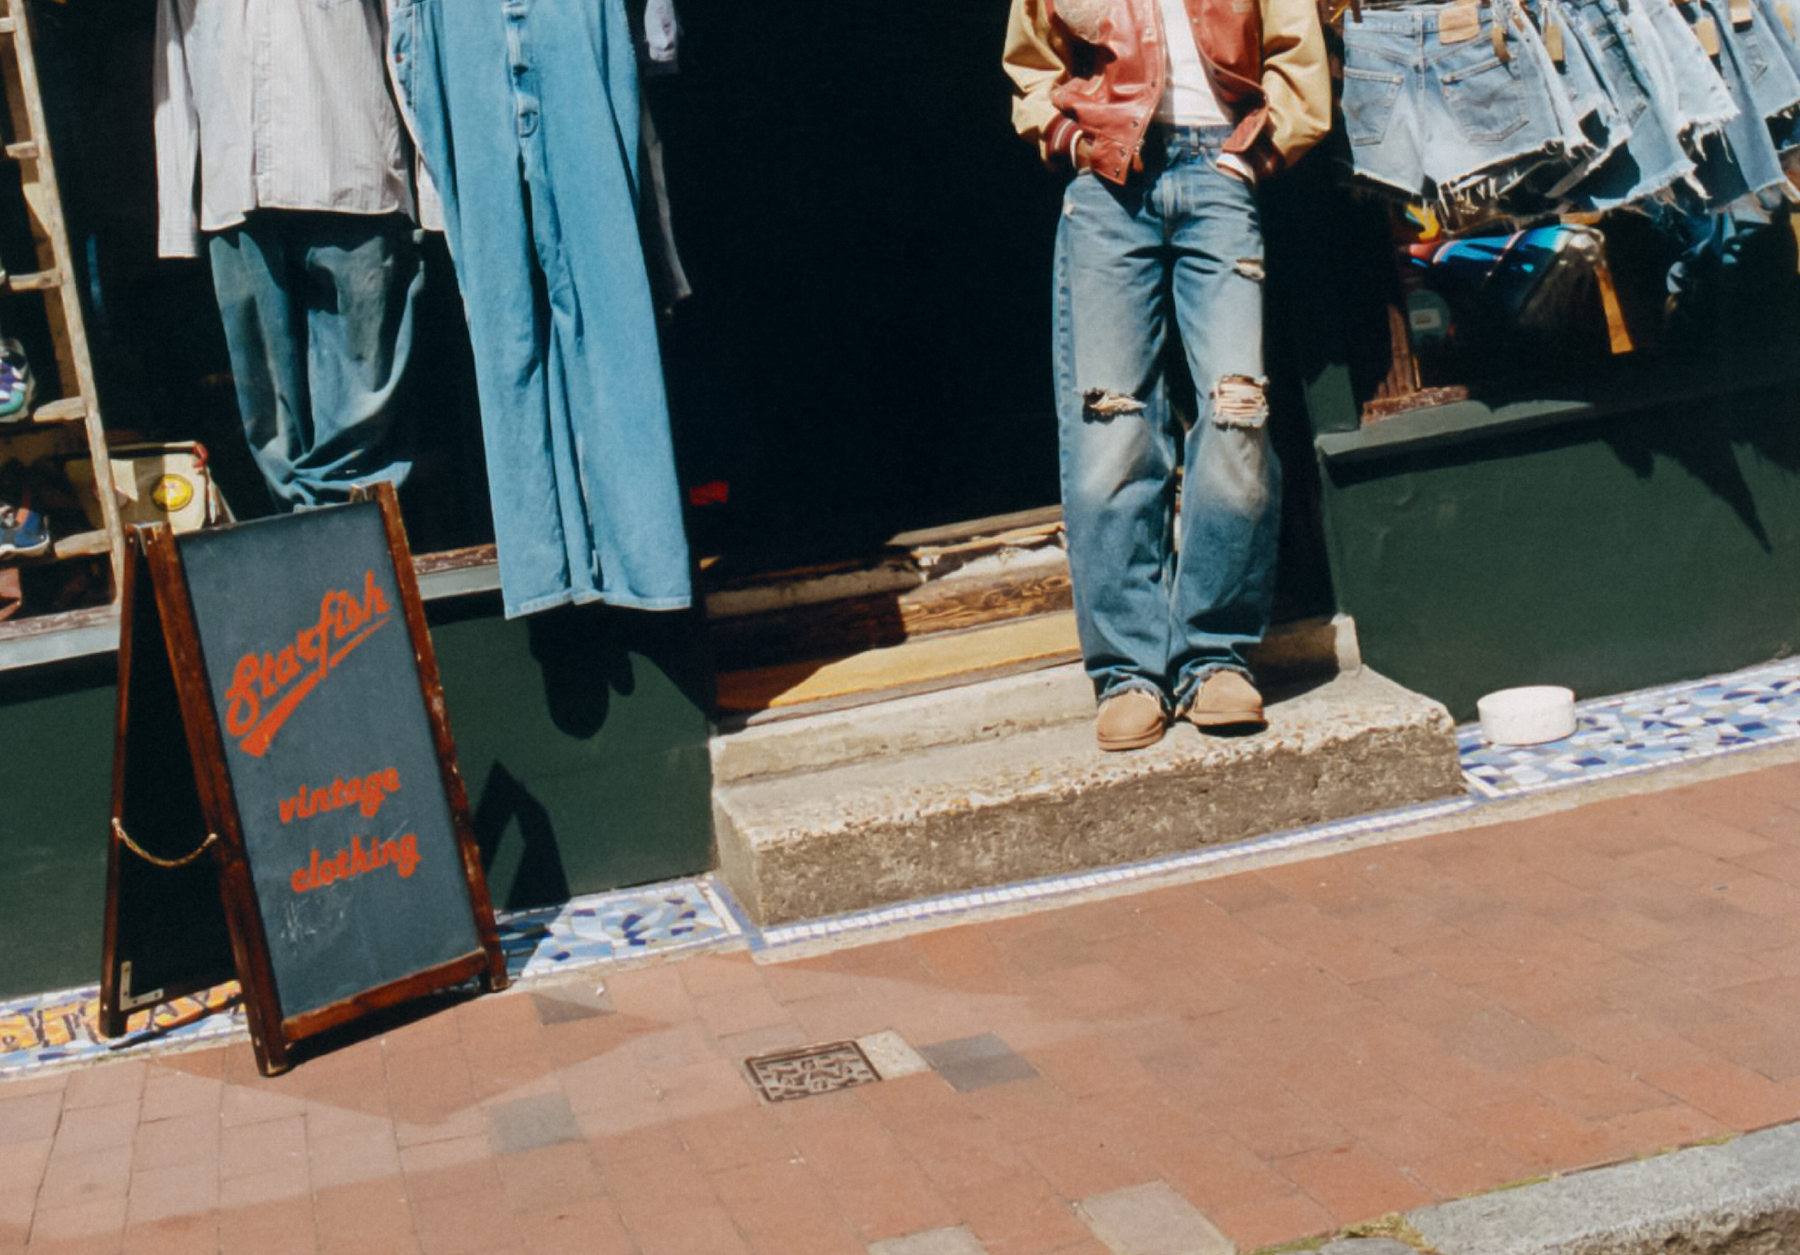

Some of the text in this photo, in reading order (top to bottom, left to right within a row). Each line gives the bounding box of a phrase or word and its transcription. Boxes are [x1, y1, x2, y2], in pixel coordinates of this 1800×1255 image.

[225, 568, 391, 737] Starfish
[279, 766, 402, 825] vintage
[290, 832, 422, 894] clothing
